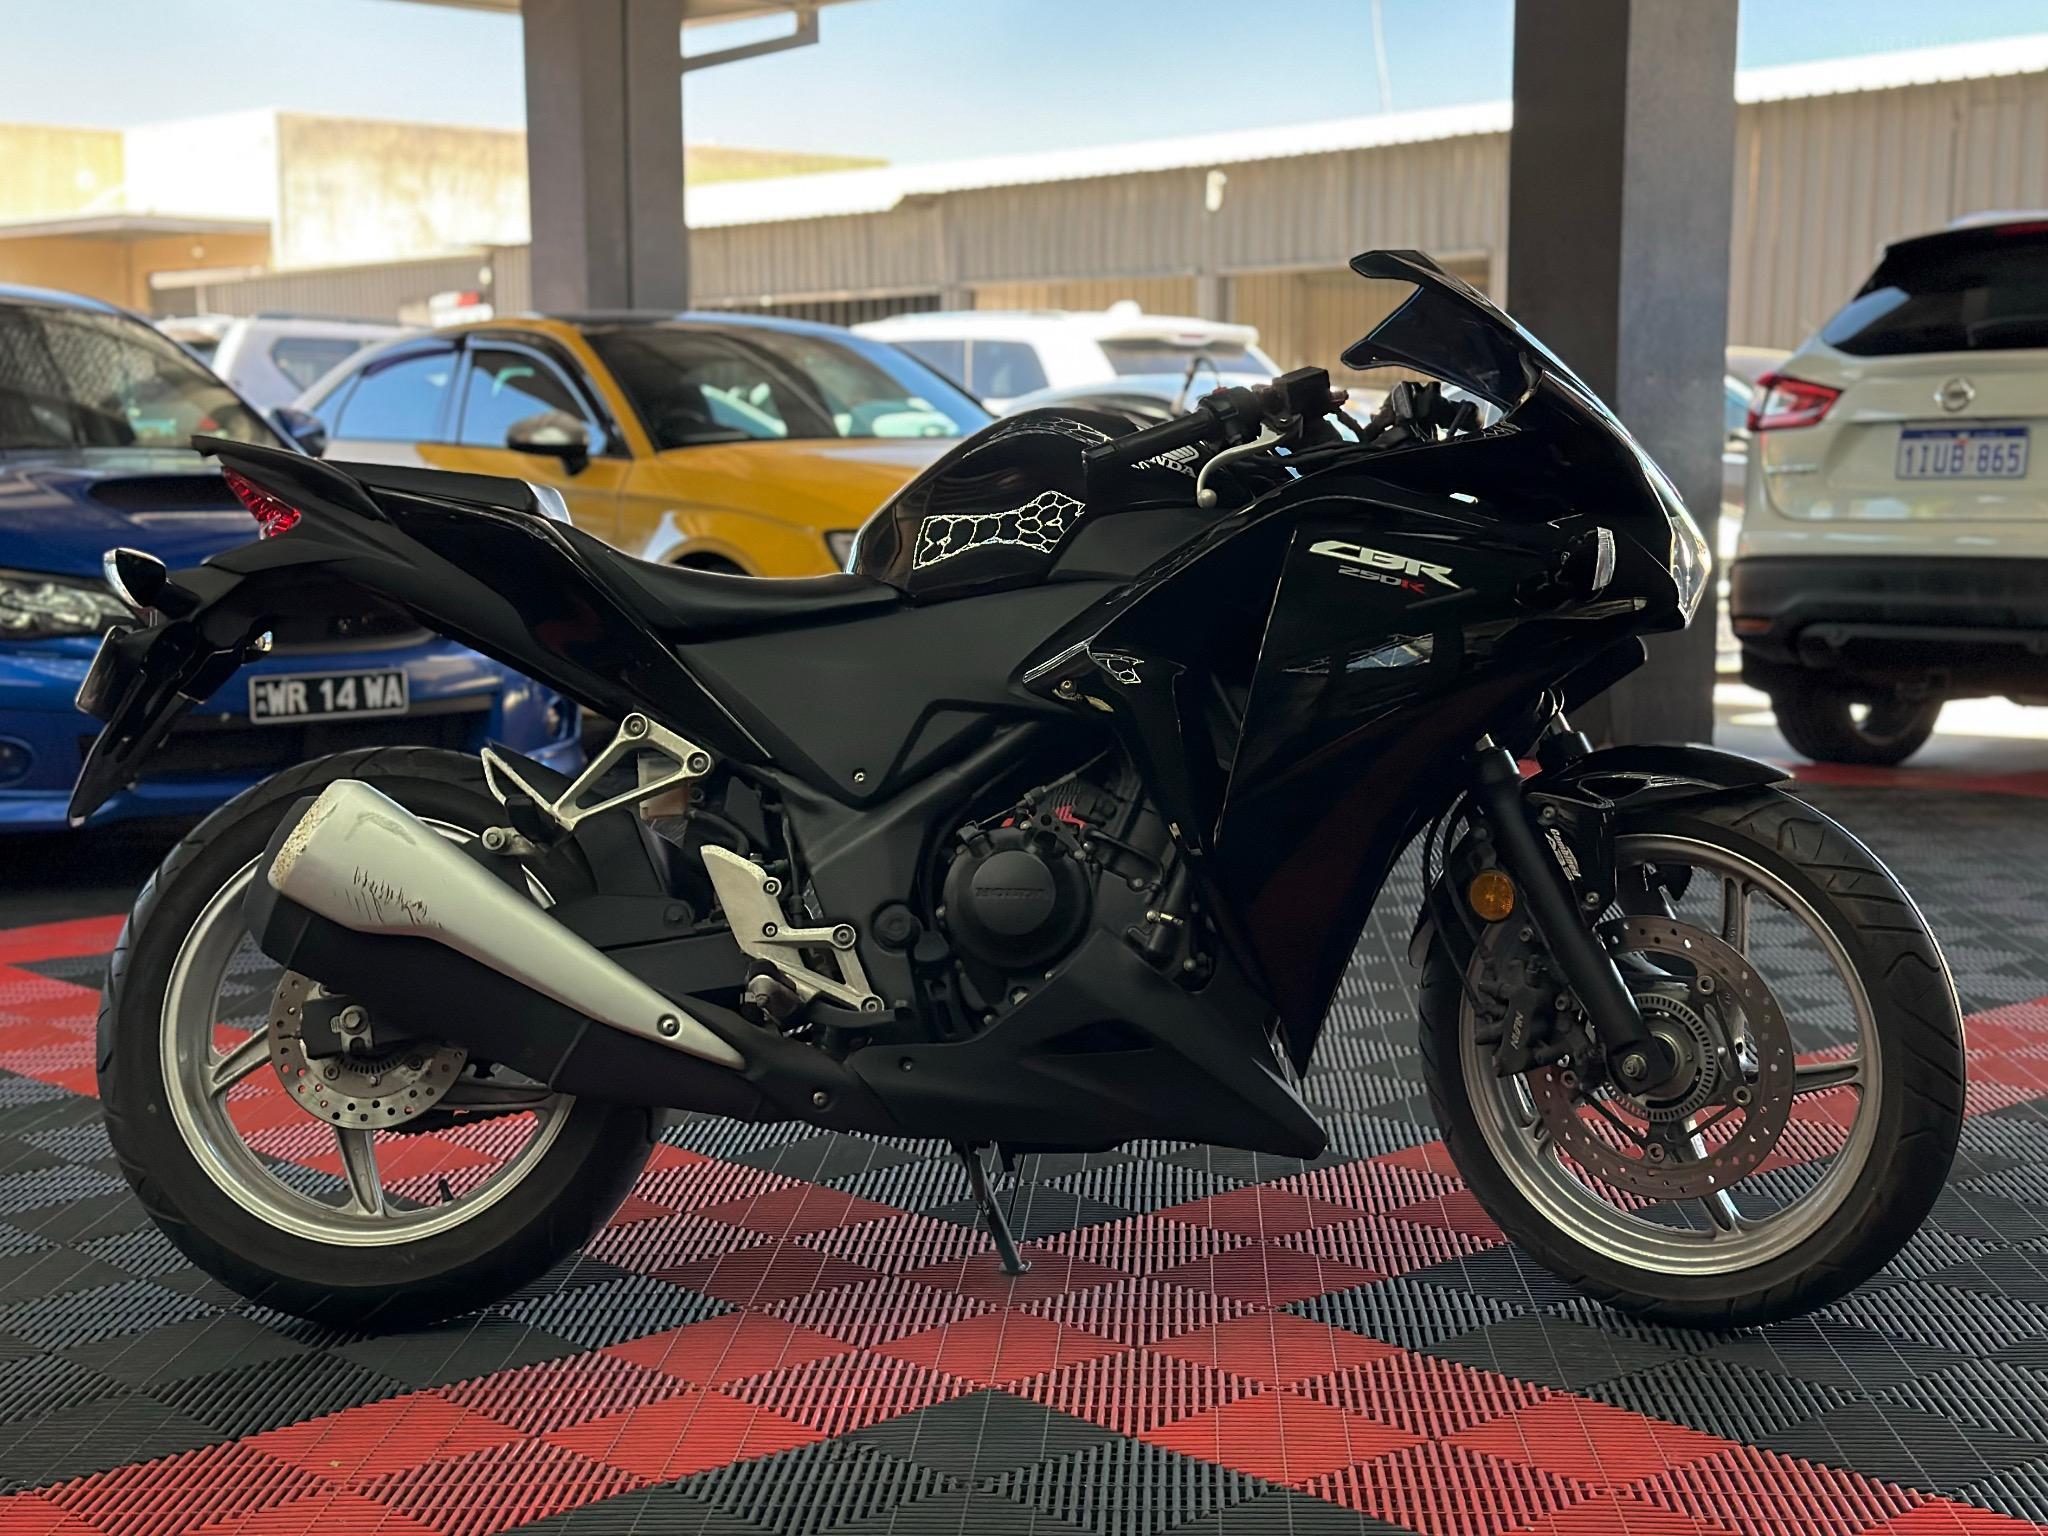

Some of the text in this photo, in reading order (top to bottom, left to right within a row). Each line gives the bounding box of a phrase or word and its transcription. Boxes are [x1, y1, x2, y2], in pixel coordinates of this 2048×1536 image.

[1309, 540, 1462, 590] CBR
[266, 680, 309, 716] WR
[319, 677, 357, 712] 14
[363, 674, 403, 709] WA
